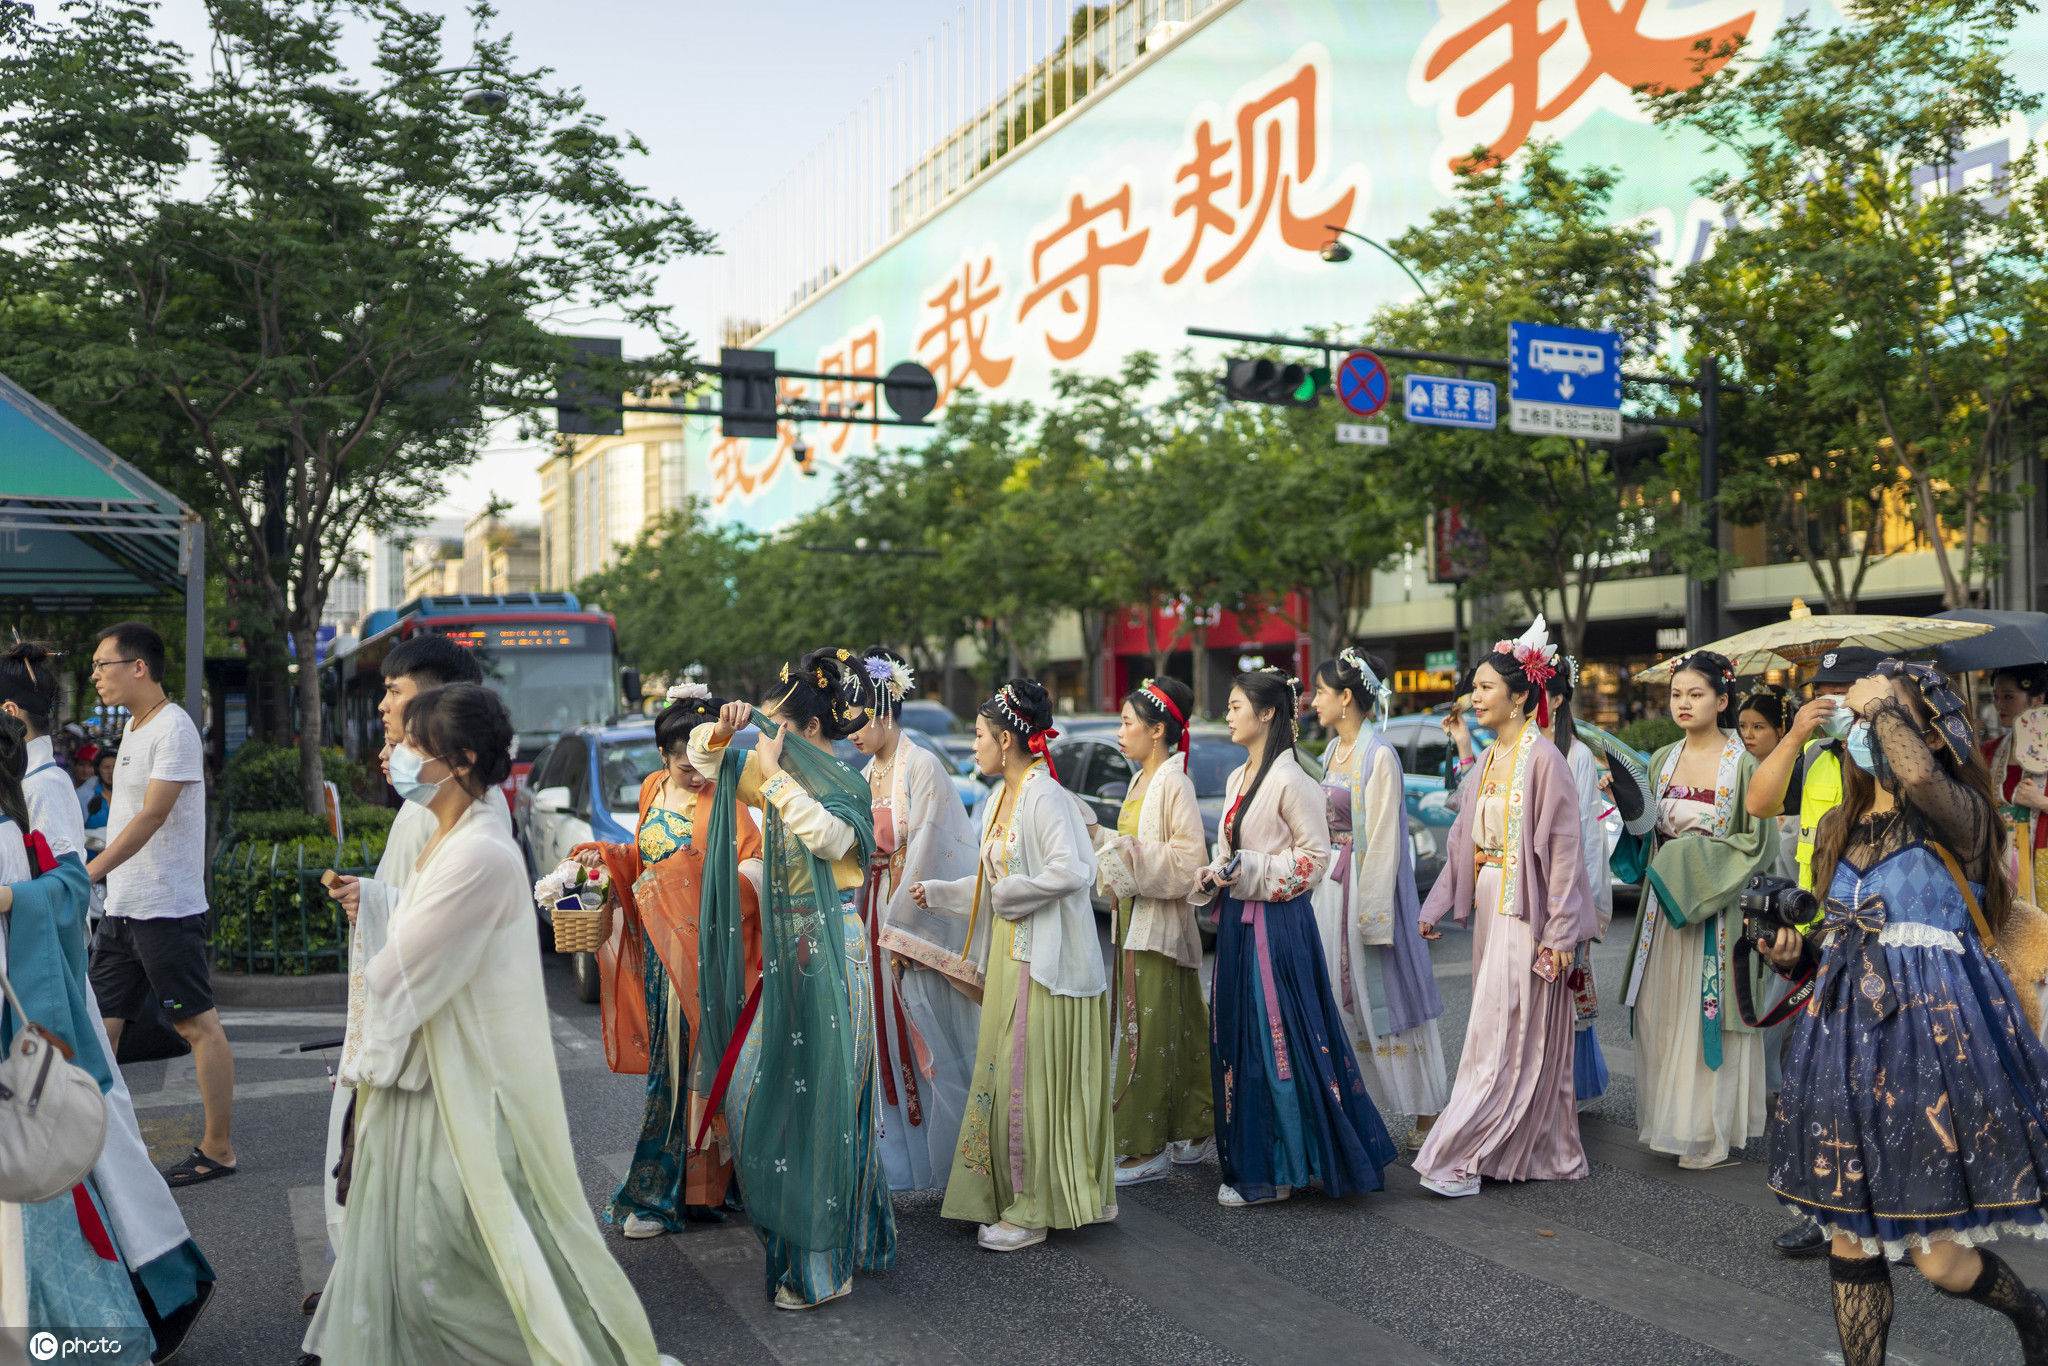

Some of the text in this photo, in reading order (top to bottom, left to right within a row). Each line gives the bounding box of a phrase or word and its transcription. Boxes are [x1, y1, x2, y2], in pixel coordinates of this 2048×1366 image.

[1431, 383, 1490, 412] 延安路
[1519, 408, 1551, 427] 工作日
[1789, 979, 1816, 1005] Canon
